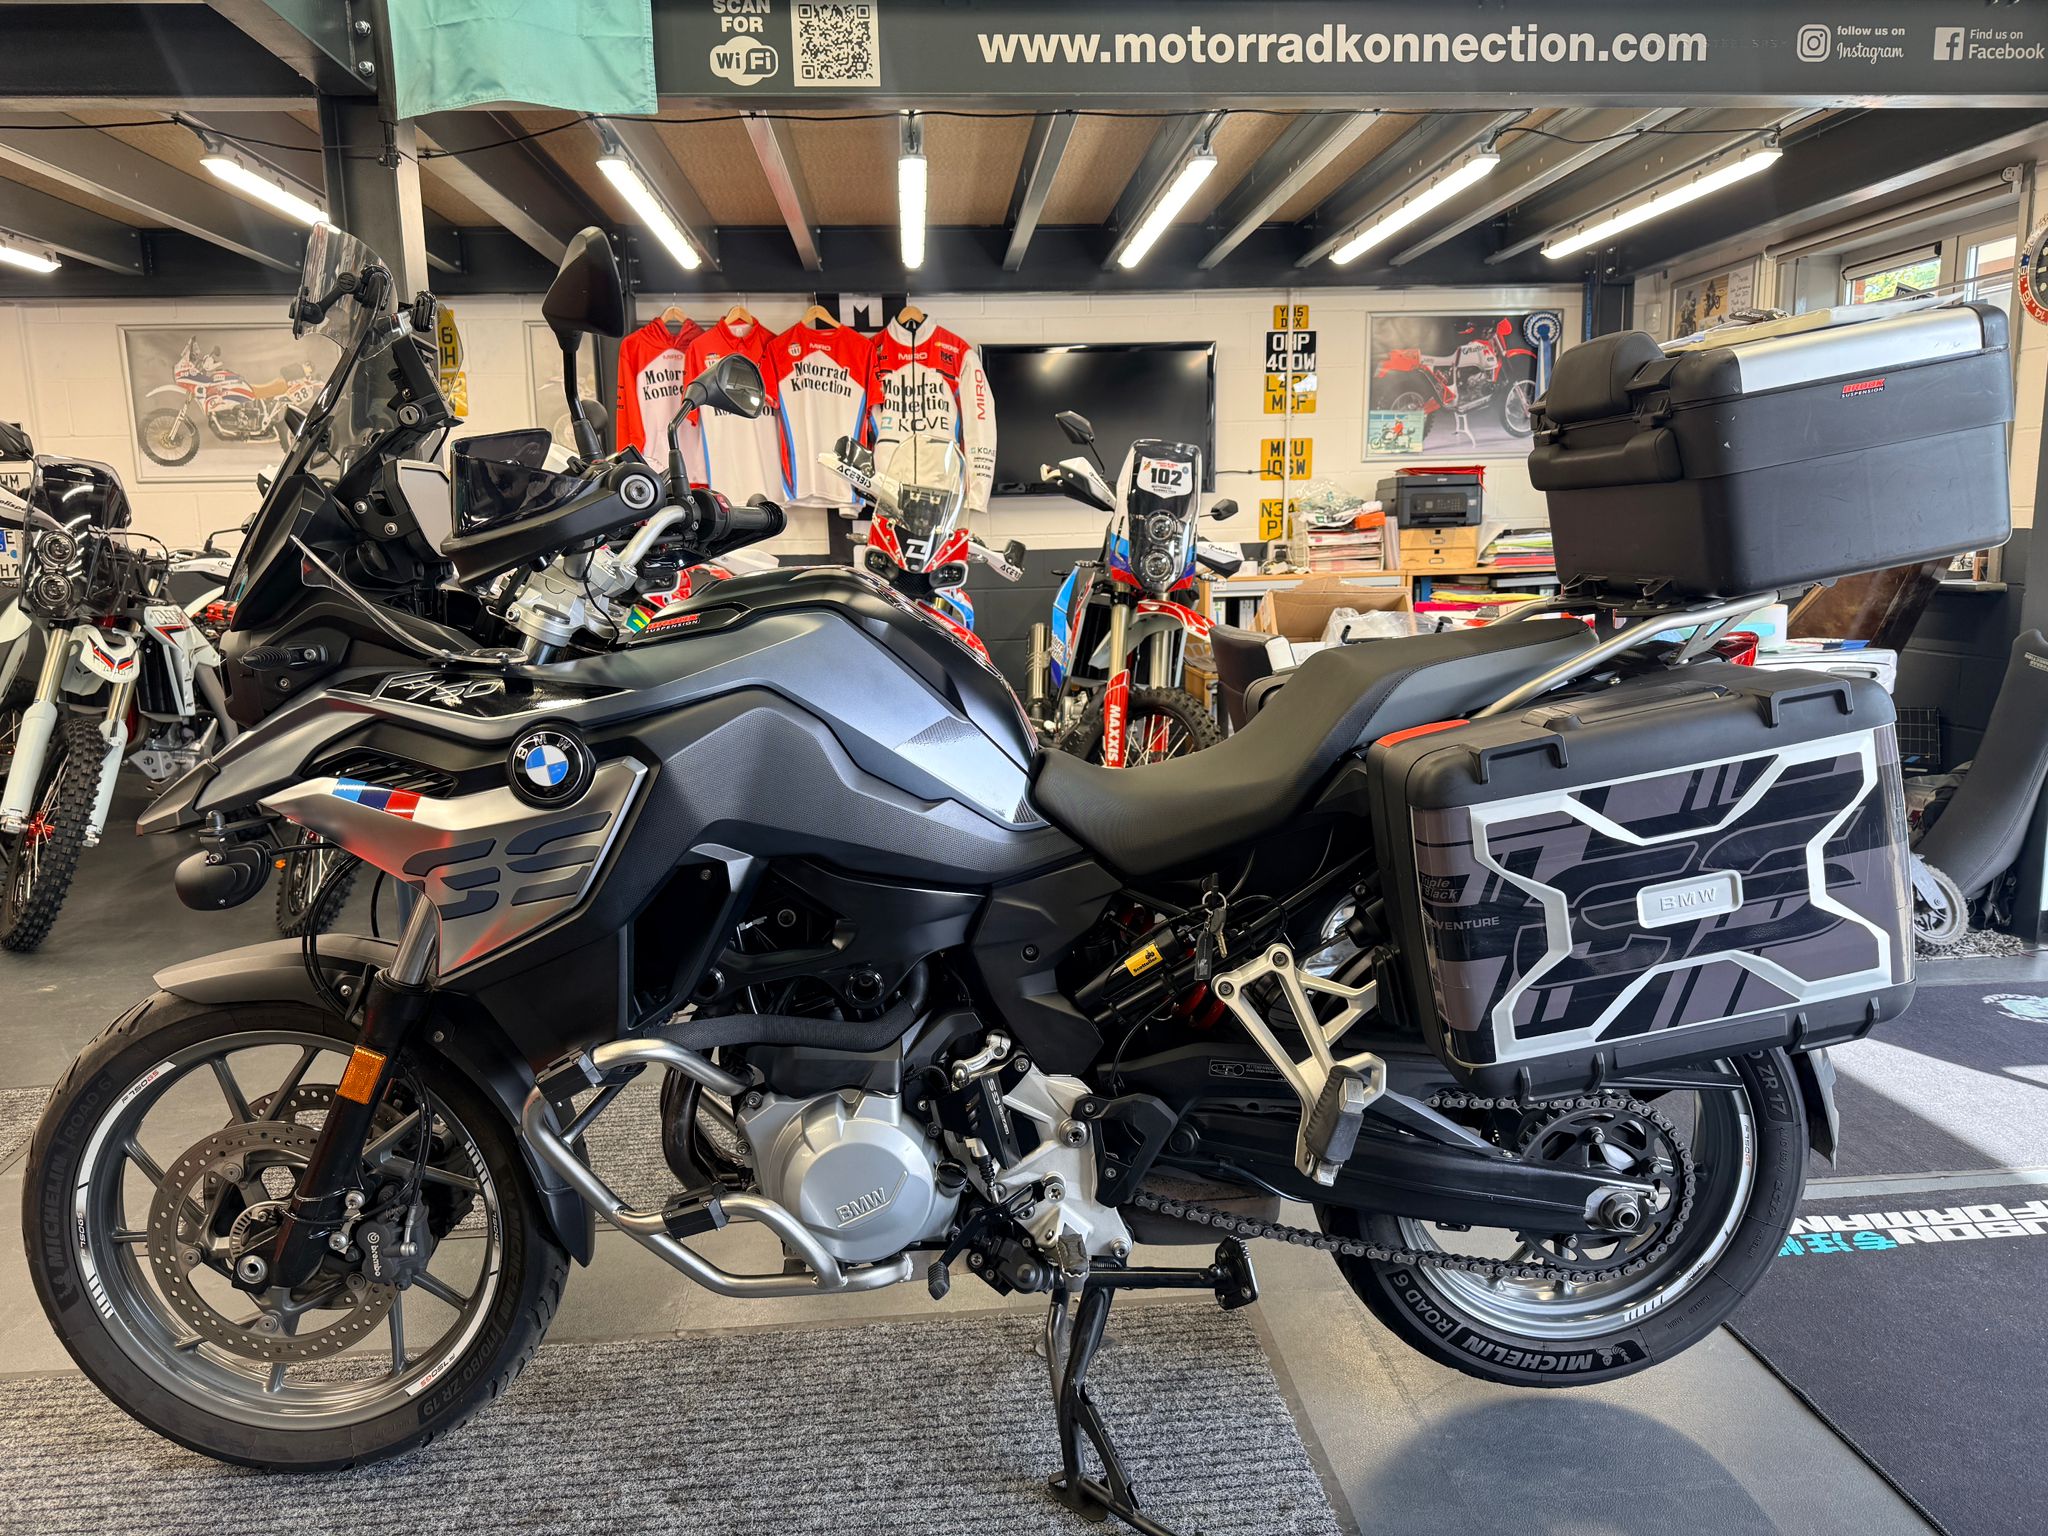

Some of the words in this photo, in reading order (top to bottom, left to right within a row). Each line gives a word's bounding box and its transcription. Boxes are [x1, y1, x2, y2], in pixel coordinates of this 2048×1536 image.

[713, 0, 771, 14] SCAN
[721, 17, 764, 33] FOR
[1837, 26, 1871, 36] follow
[1875, 28, 1888, 36] us
[1891, 28, 1905, 36] on
[1970, 29, 1993, 40] Find
[1995, 31, 2007, 40] us
[2010, 31, 2023, 40] on
[978, 24, 1707, 63] www.motorradkonnection.com
[1837, 42, 1905, 64] Instagram
[1969, 44, 2046, 59] Facebook
[898, 352, 928, 361] MIRO
[794, 361, 849, 382] Motorrad
[974, 369, 986, 420] MIRO
[1841, 386, 1884, 398] SUSPENSION
[836, 464, 872, 489] ACERBIS
[1151, 467, 1182, 487] 102
[515, 734, 571, 760] BMW
[1660, 887, 1716, 911] BMW
[1759, 1063, 1779, 1091] ZR
[1769, 1093, 1787, 1117] 17
[64, 1091, 99, 1139] ROAD
[43, 1154, 68, 1267] MICHELIN
[834, 1187, 887, 1222] BMW
[370, 1245, 382, 1277] brembo
[1393, 1273, 1410, 1287] 6
[1404, 1289, 1455, 1333] ROAD
[1461, 1335, 1594, 1372] MICHELIN
